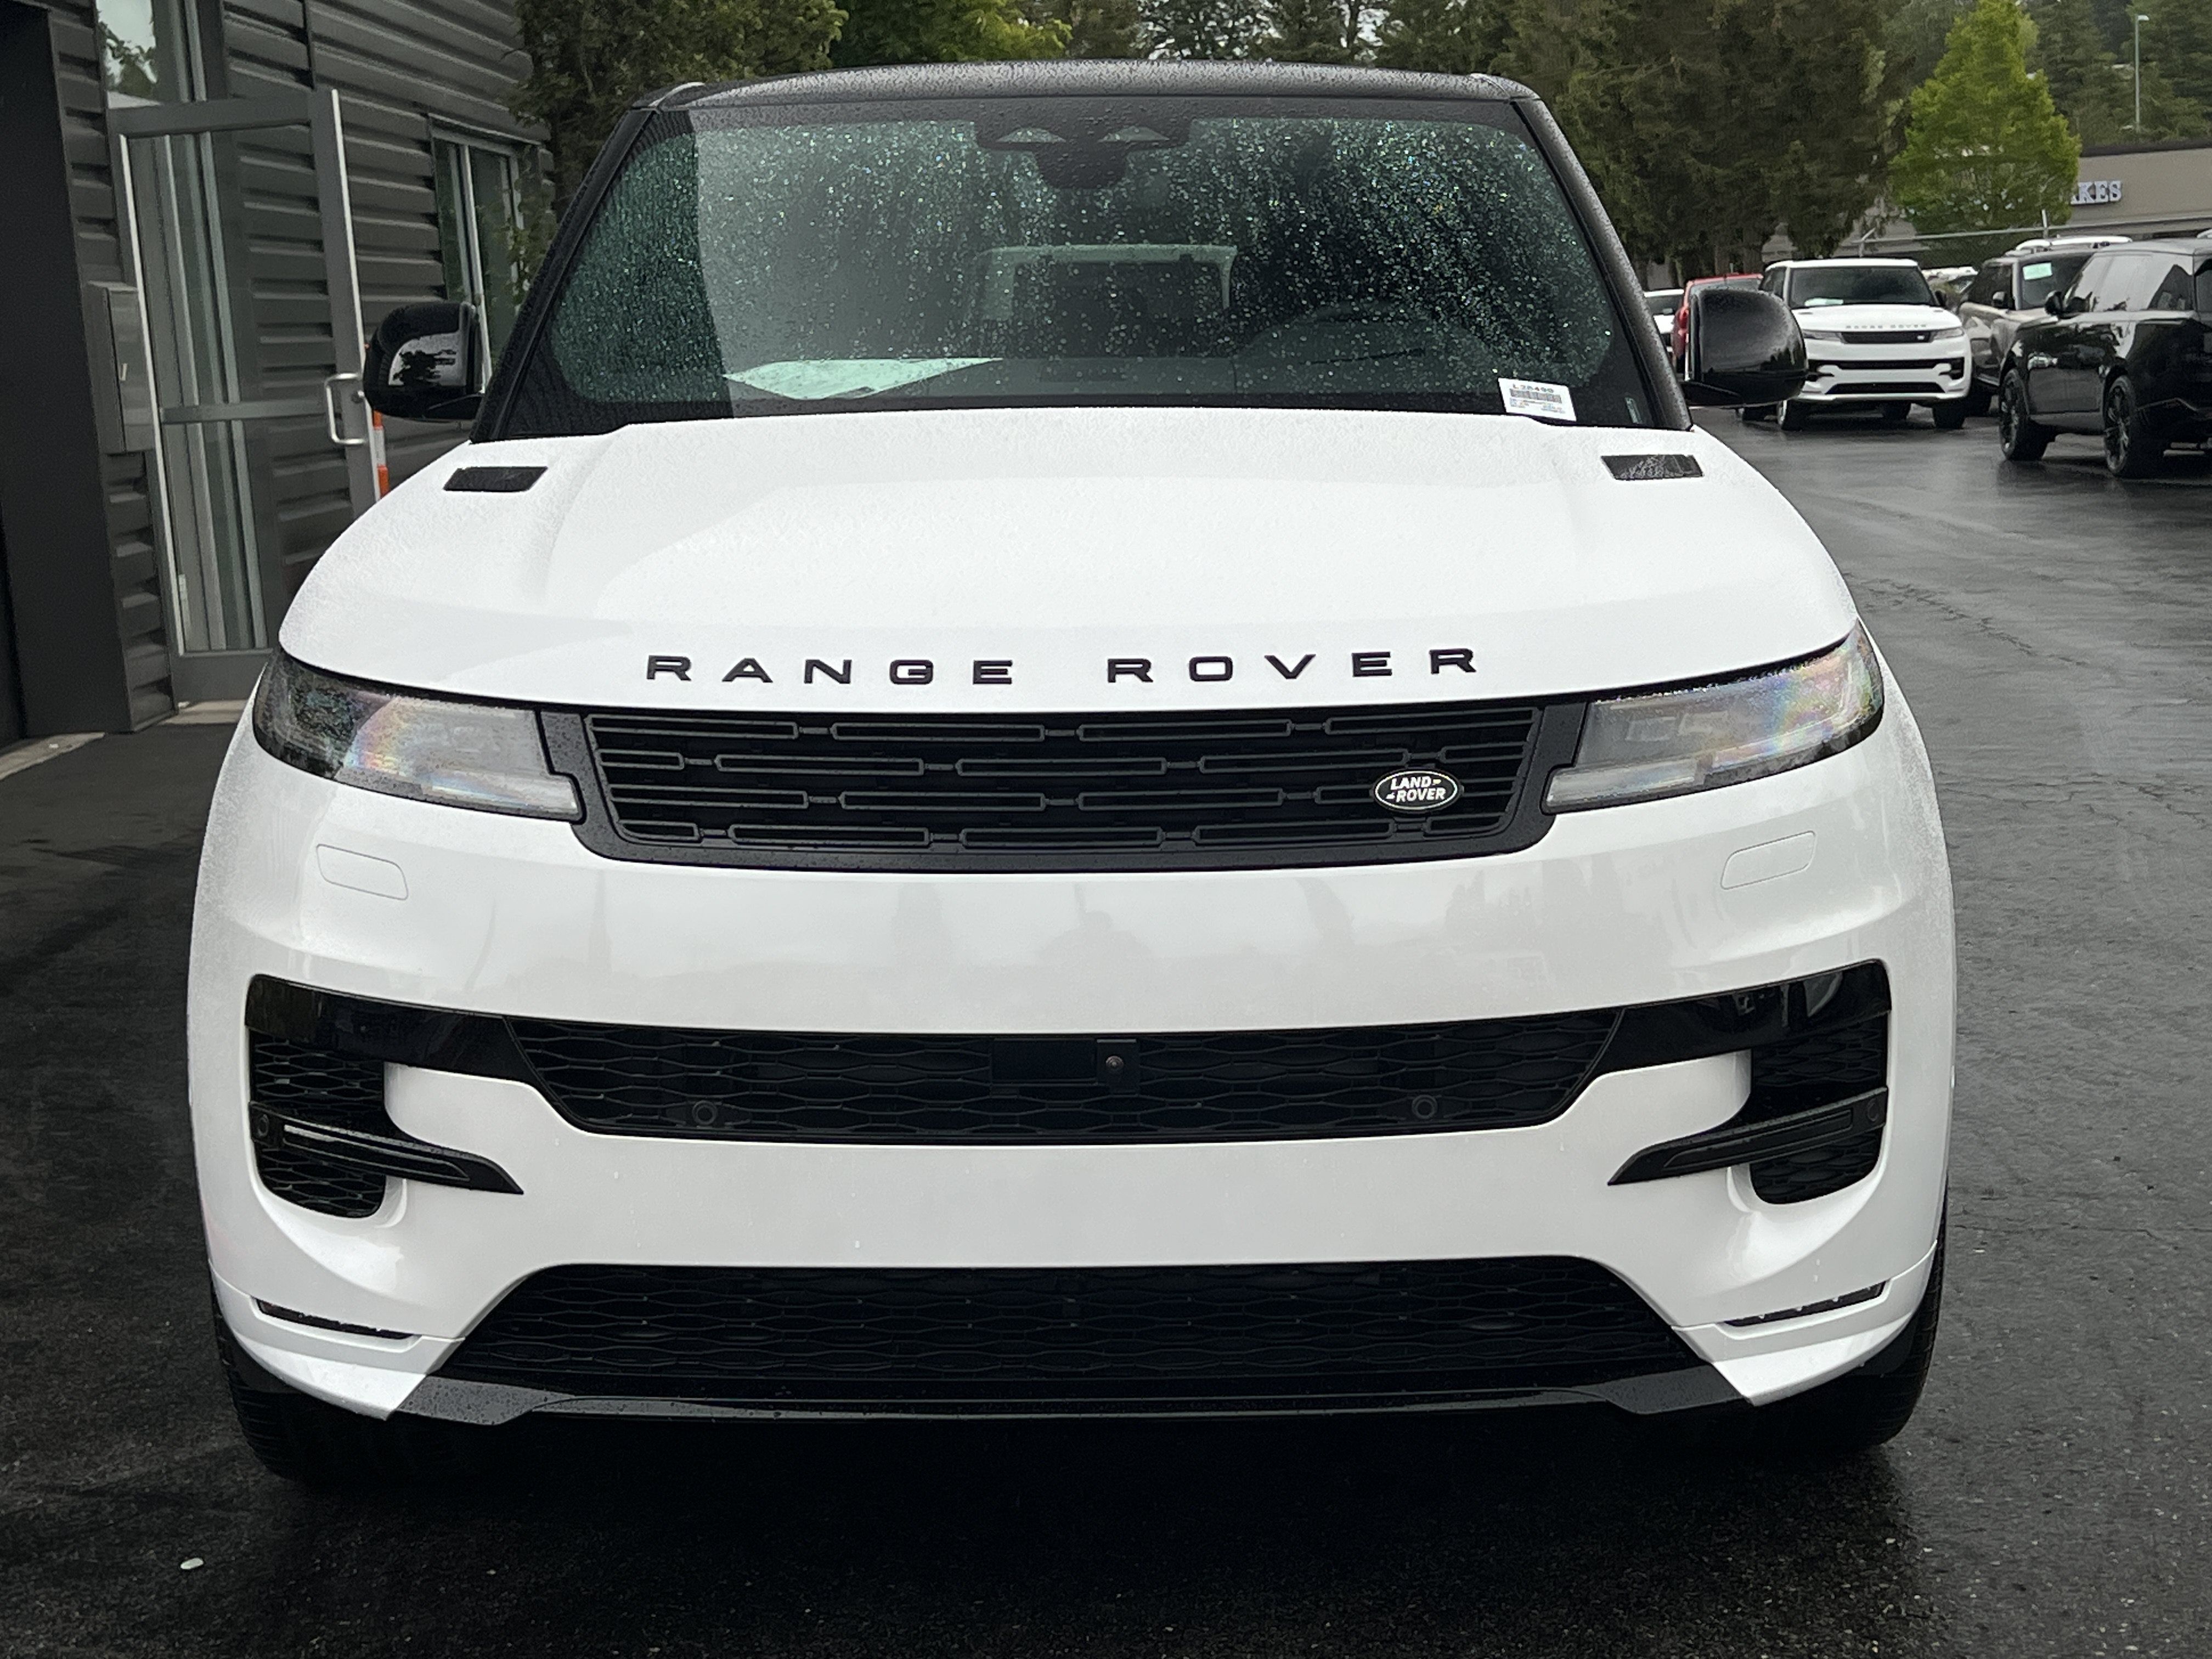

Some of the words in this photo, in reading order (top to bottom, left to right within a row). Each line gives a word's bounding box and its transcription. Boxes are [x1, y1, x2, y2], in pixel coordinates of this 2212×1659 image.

[646, 654, 1013, 685] RANGE
[1107, 648, 1477, 683] ROVER
[1390, 776, 1432, 790] LAND
[1396, 787, 1447, 803] ROVER
